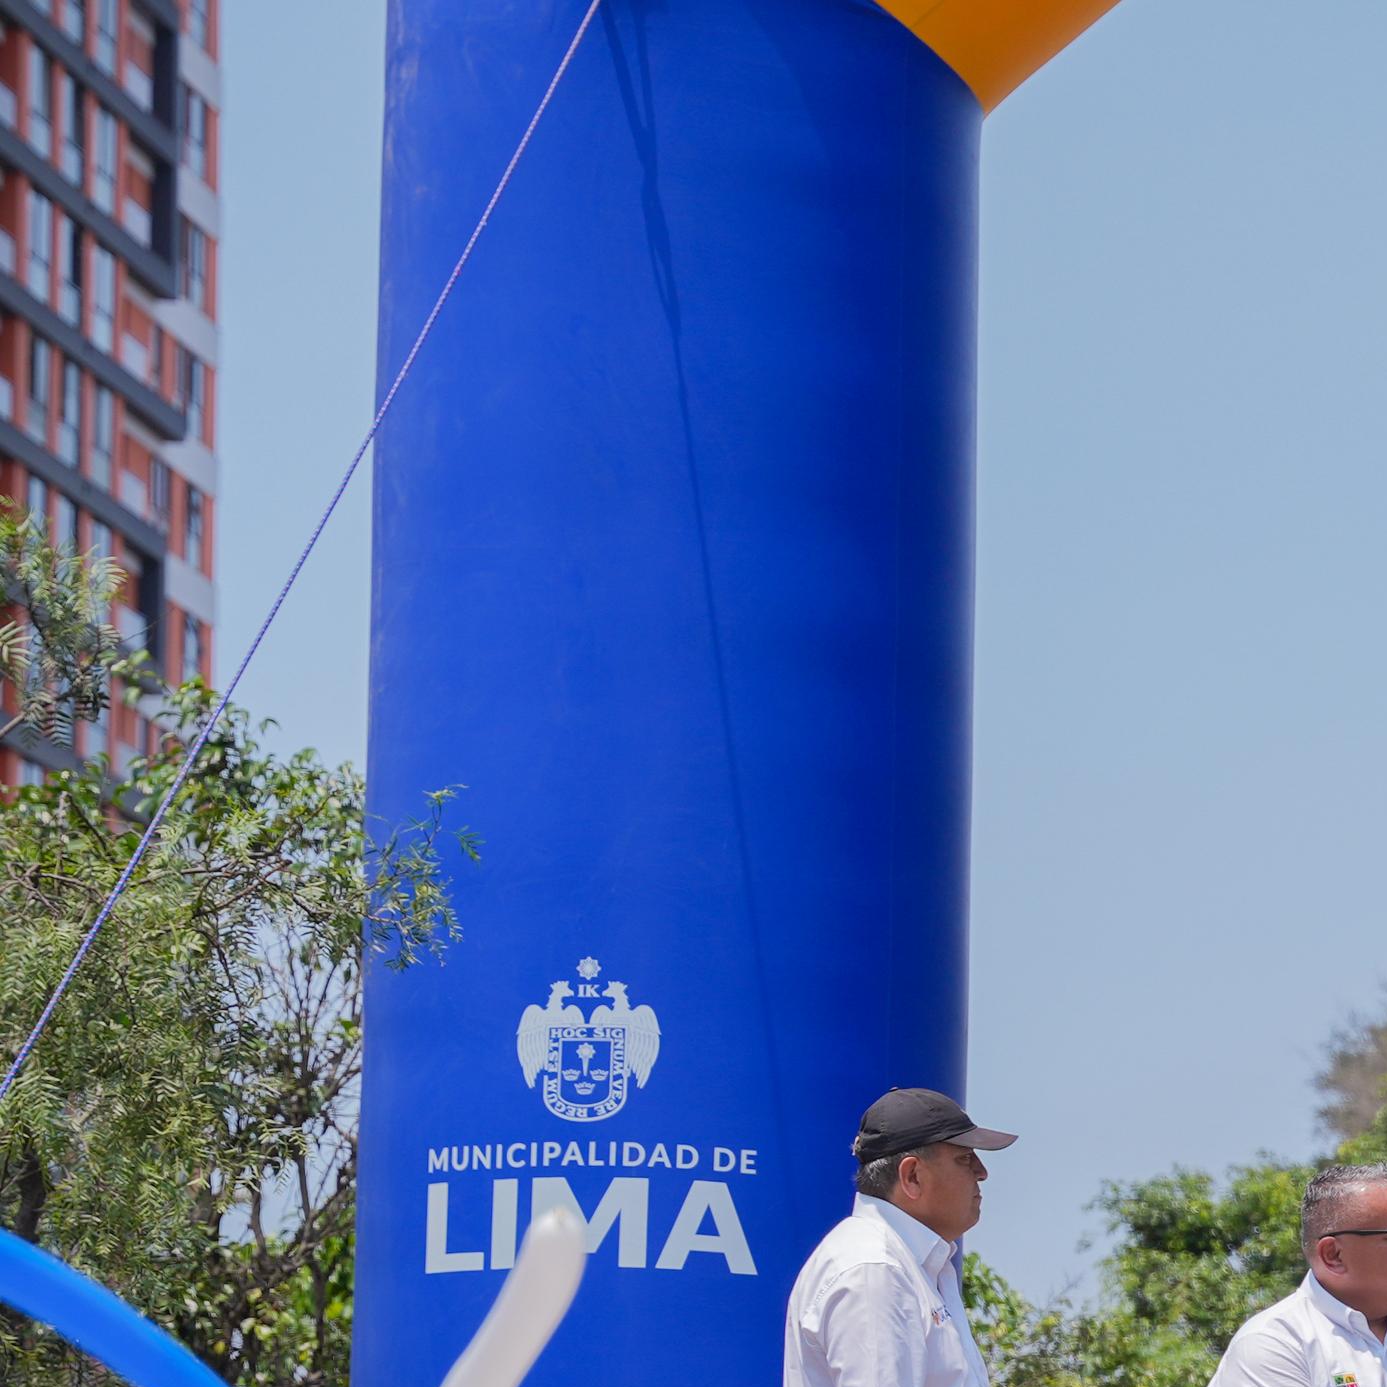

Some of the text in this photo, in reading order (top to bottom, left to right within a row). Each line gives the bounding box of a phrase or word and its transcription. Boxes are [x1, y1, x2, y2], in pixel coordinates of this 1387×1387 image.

[577, 984, 600, 998] IK
[550, 1027, 588, 1039] HOC
[427, 1141, 758, 1175] MUNICIPALIDAD DE
[425, 1176, 759, 1275] LIMA
